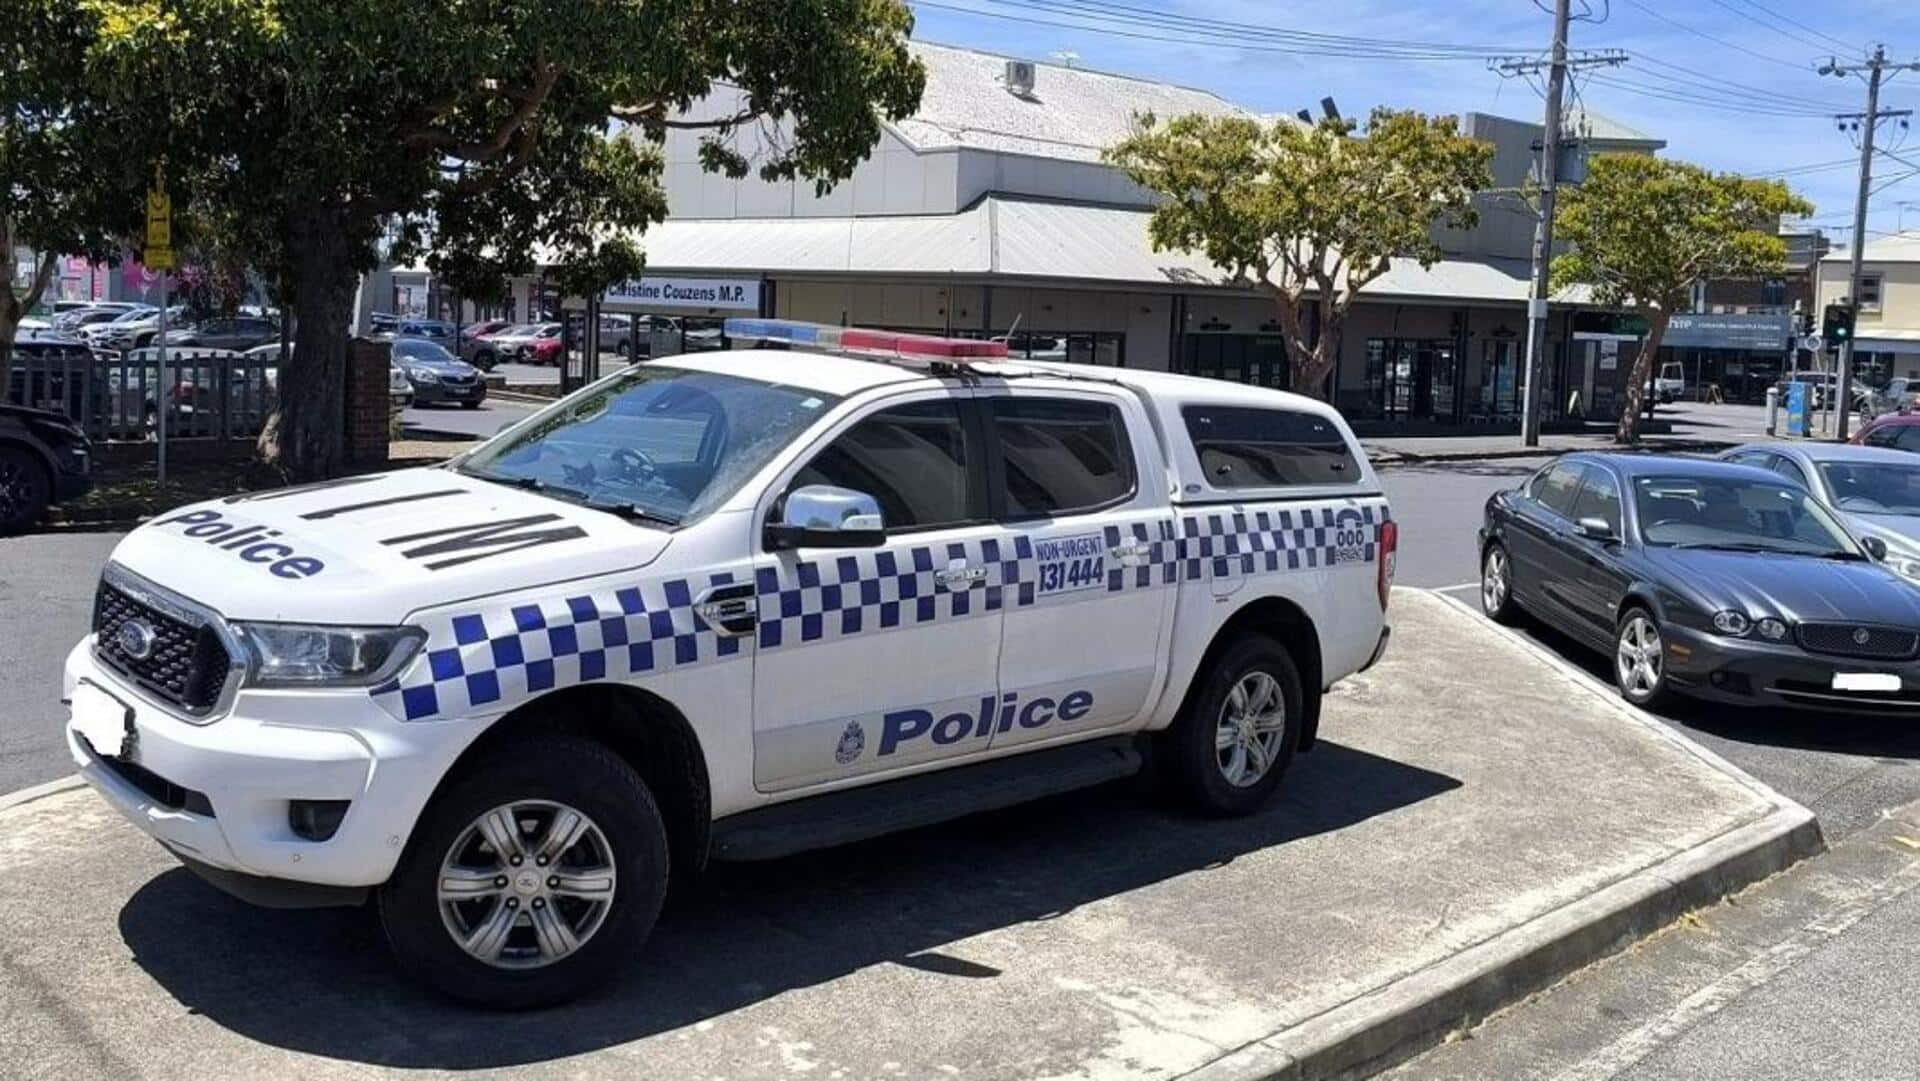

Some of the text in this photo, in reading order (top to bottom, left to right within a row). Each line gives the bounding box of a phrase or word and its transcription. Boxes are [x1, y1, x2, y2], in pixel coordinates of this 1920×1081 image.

[663, 283, 716, 301] Couzens
[719, 285, 745, 302] M.P.
[151, 509, 325, 579] Police
[1034, 536, 1103, 561] NON-URGENT
[1039, 556, 1104, 592] 131 444
[877, 690, 1094, 757] Police
